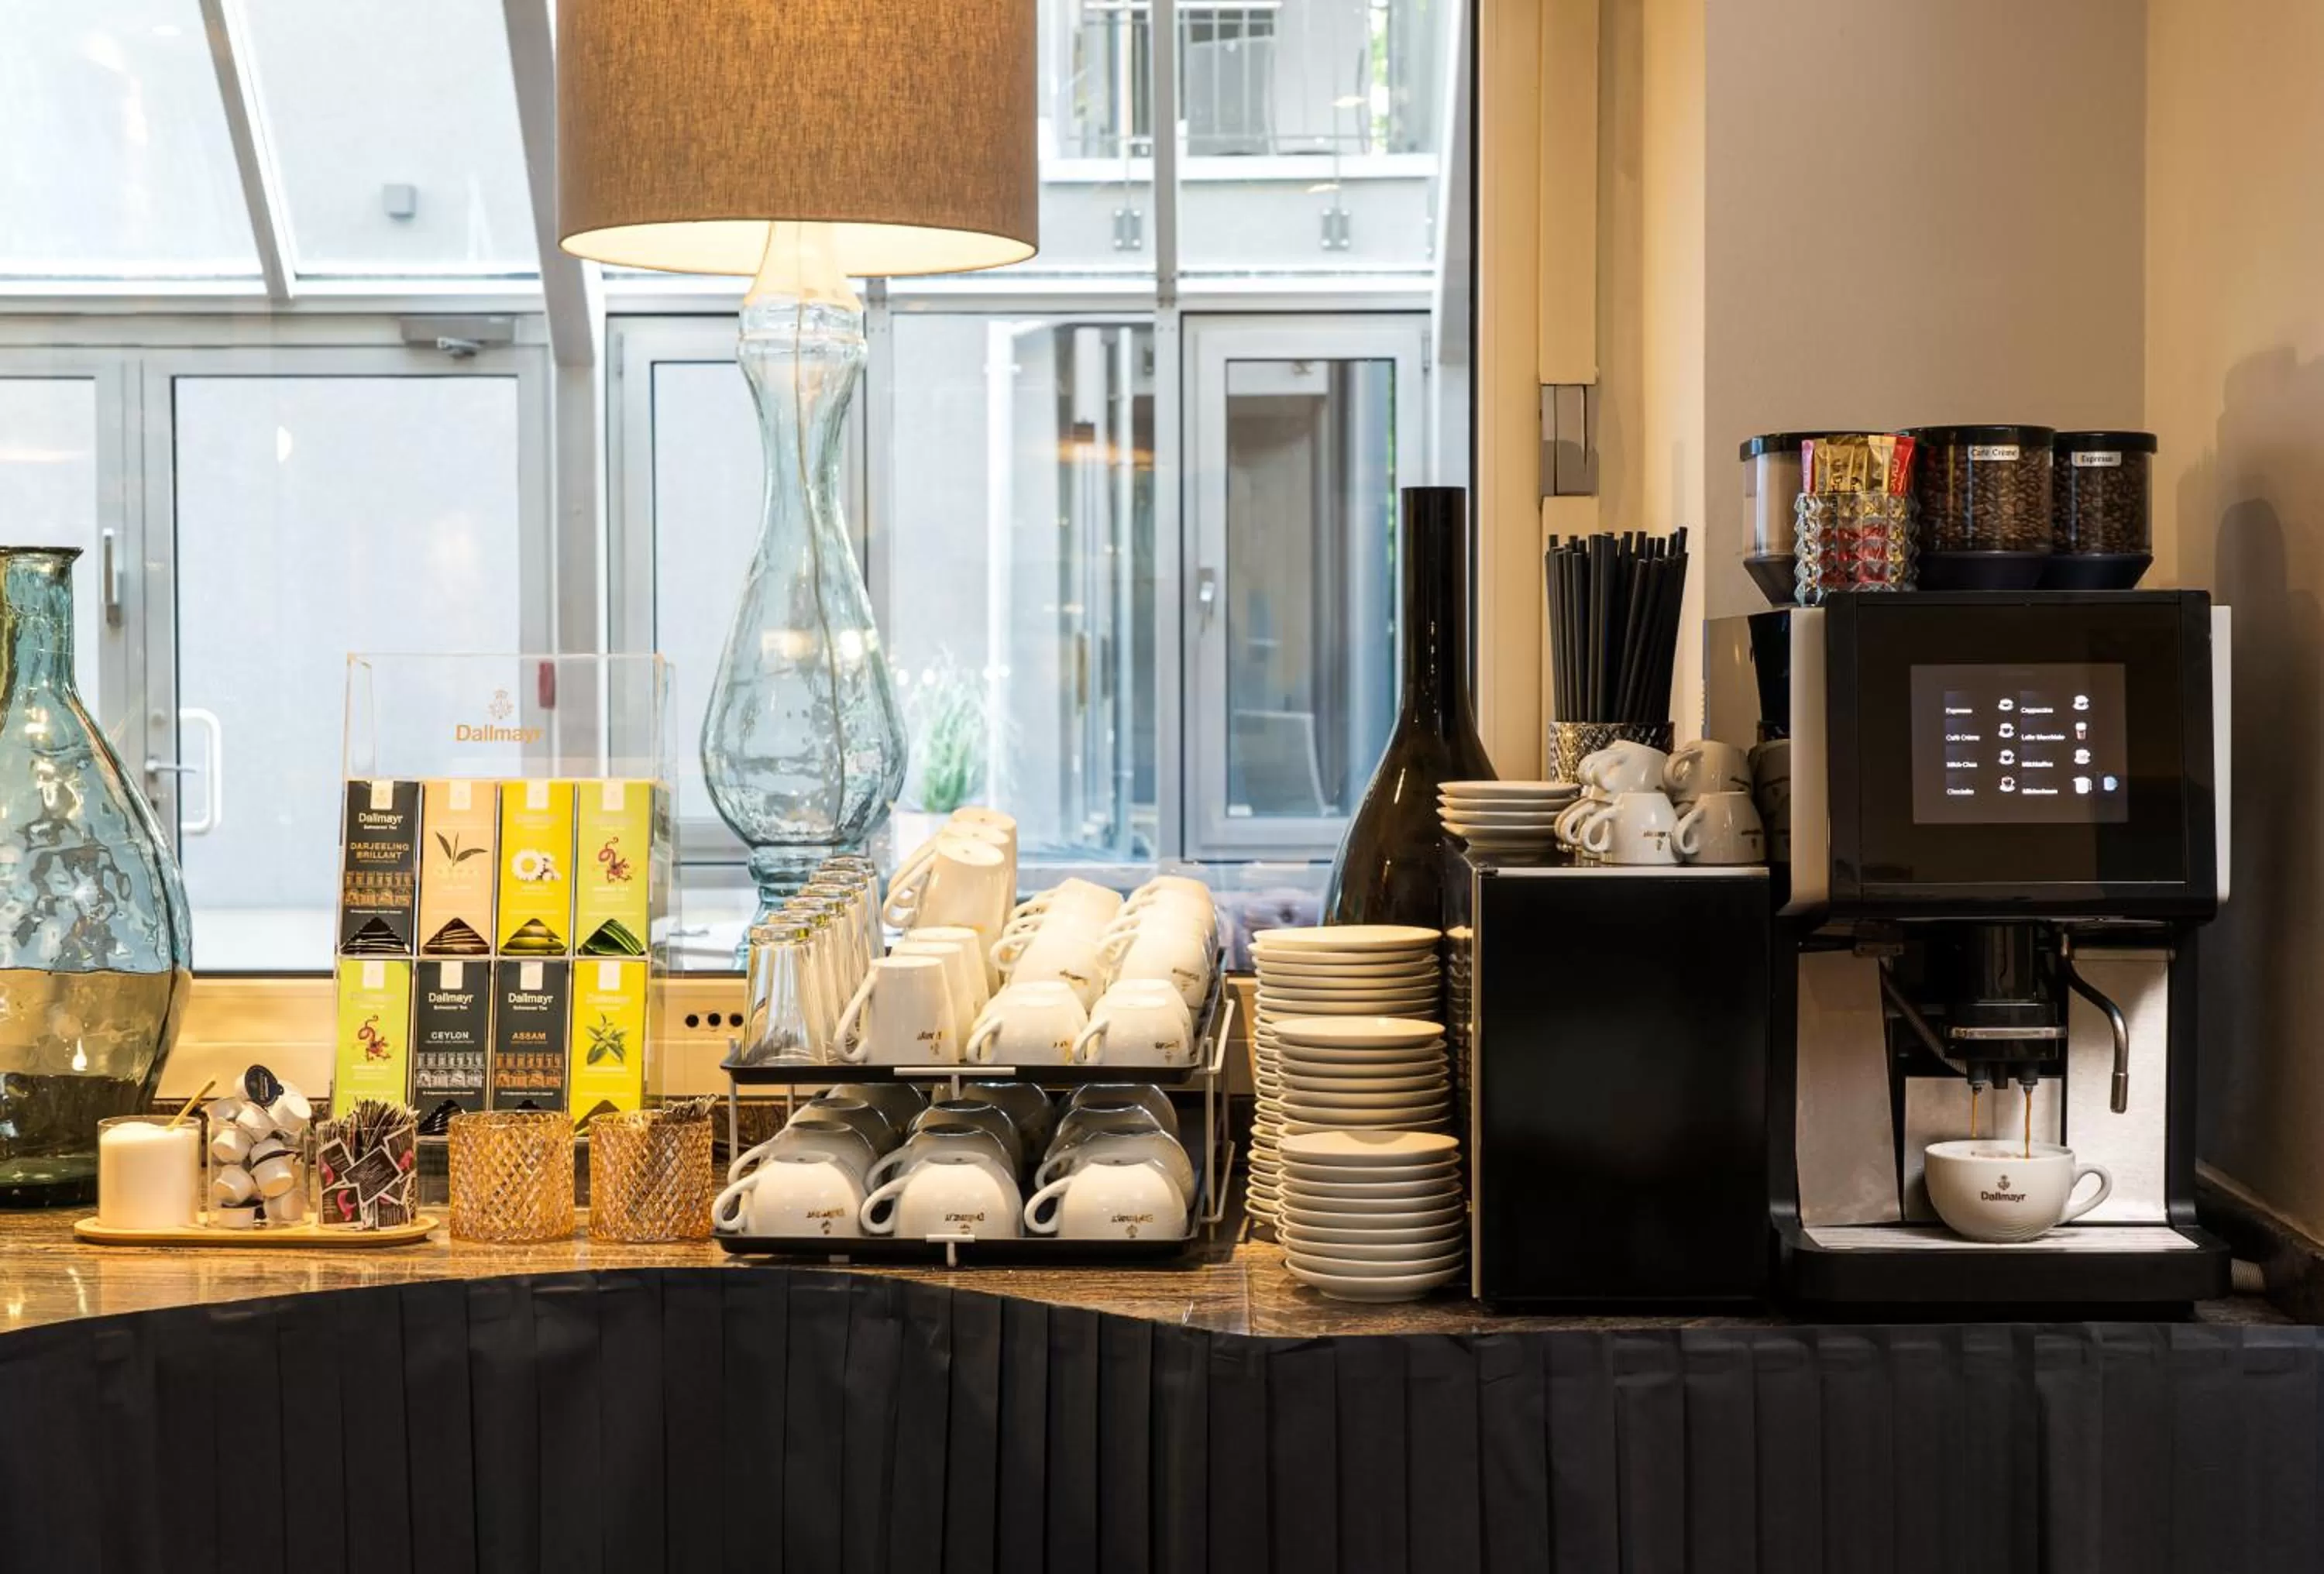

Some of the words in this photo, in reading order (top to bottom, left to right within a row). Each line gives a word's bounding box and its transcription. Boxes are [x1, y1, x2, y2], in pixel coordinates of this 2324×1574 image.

[456, 723, 545, 744] Dallmayr
[359, 812, 404, 825] Dallmayr
[350, 842, 410, 852] DARJEELING
[356, 851, 403, 860] BRILLANT
[428, 991, 474, 1005] Dallmayr
[507, 992, 554, 1005] Dallmayr
[431, 1031, 469, 1040] CEYLON
[512, 1032, 546, 1040] ASSAM
[1981, 1191, 2027, 1203] Dallmayr
